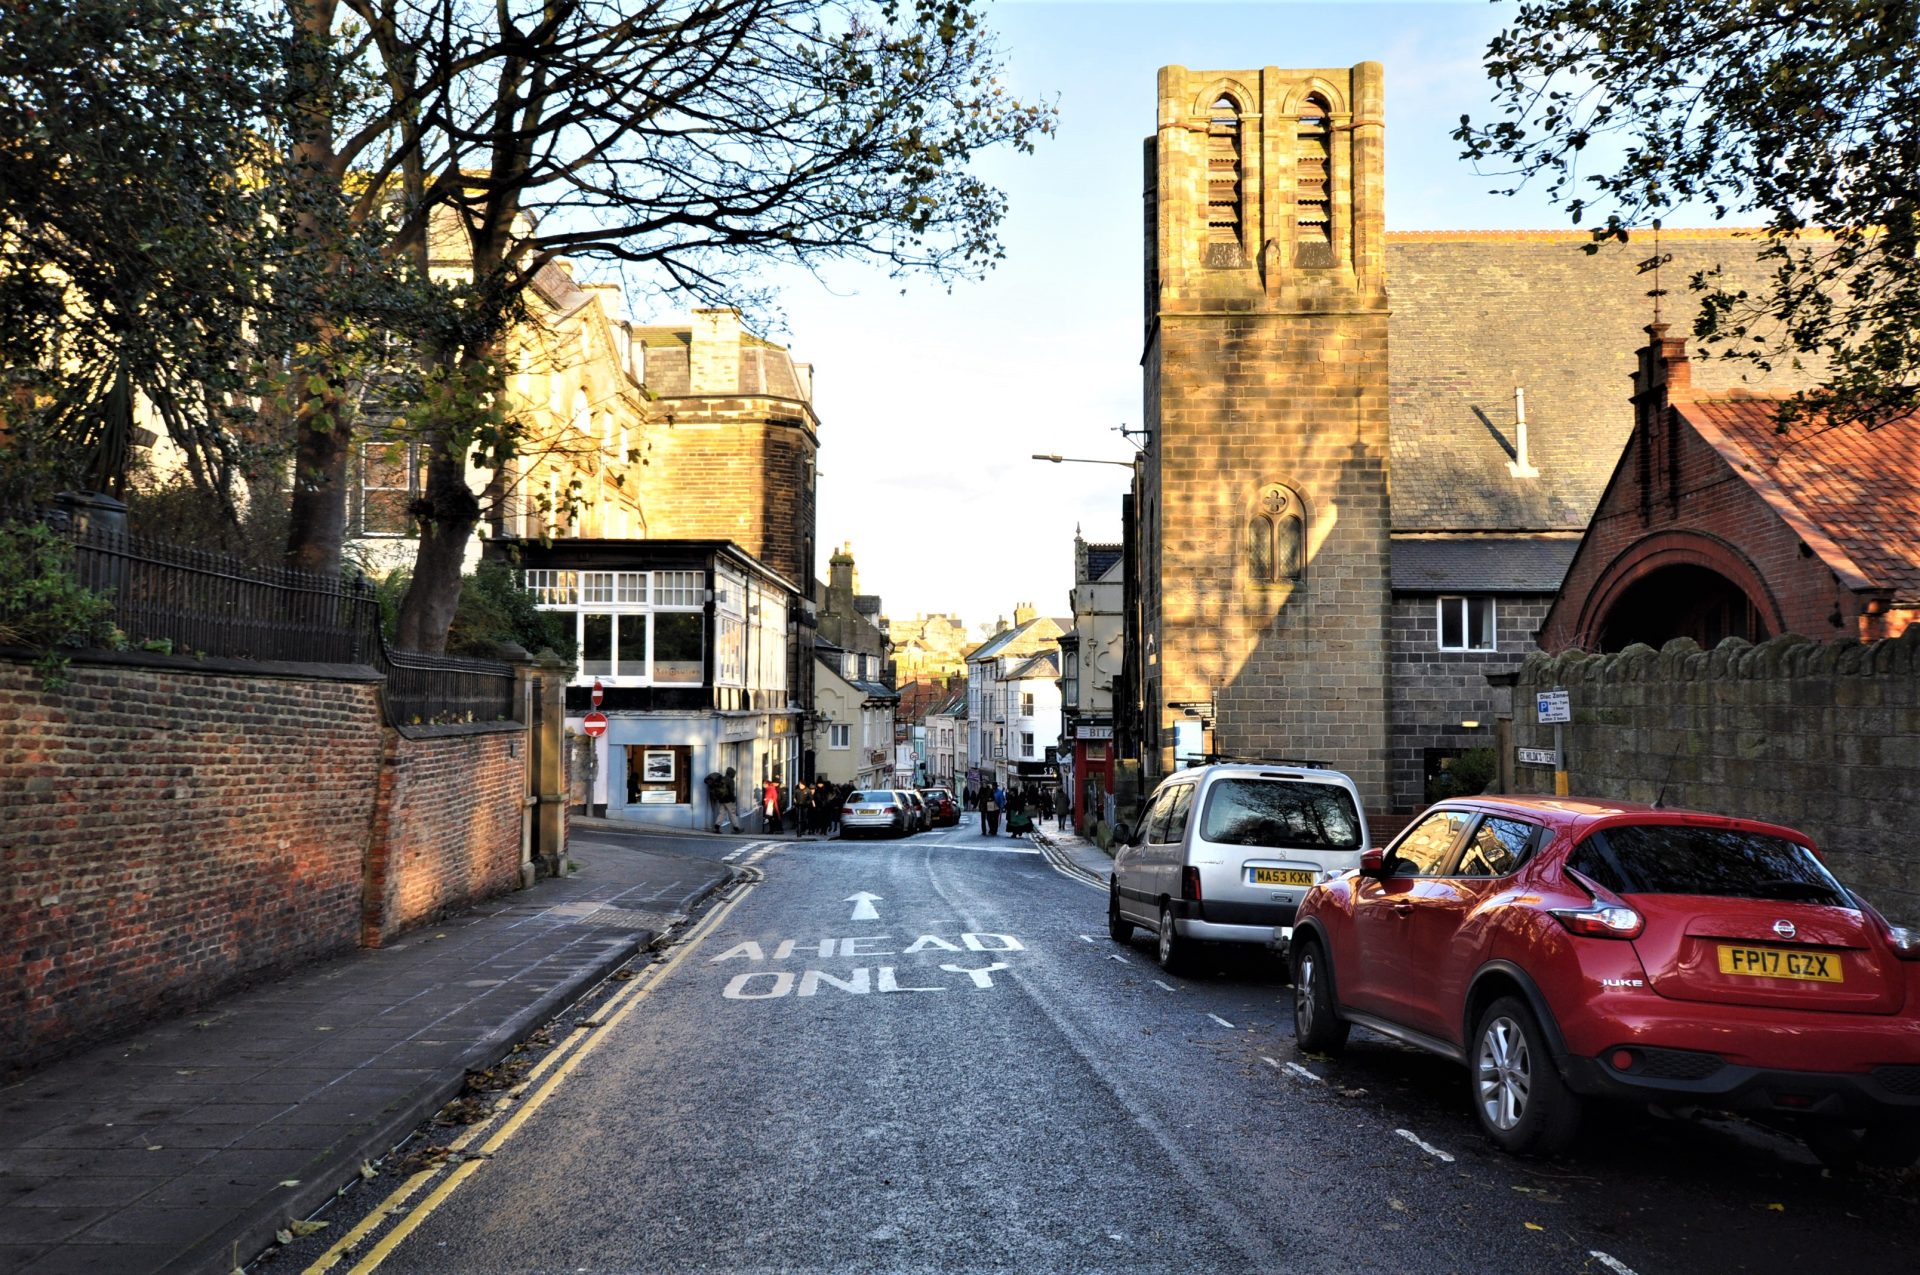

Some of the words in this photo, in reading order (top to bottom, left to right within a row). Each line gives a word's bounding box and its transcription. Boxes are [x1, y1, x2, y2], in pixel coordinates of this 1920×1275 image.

[1257, 870, 1287, 883] MA53
[1289, 872, 1312, 884] KXN
[709, 933, 1025, 962] AHEAD
[1732, 949, 1780, 973] FP17
[1787, 953, 1829, 977] GZX
[723, 962, 1010, 999] ONLY
[1602, 979, 1643, 987] JUKE
